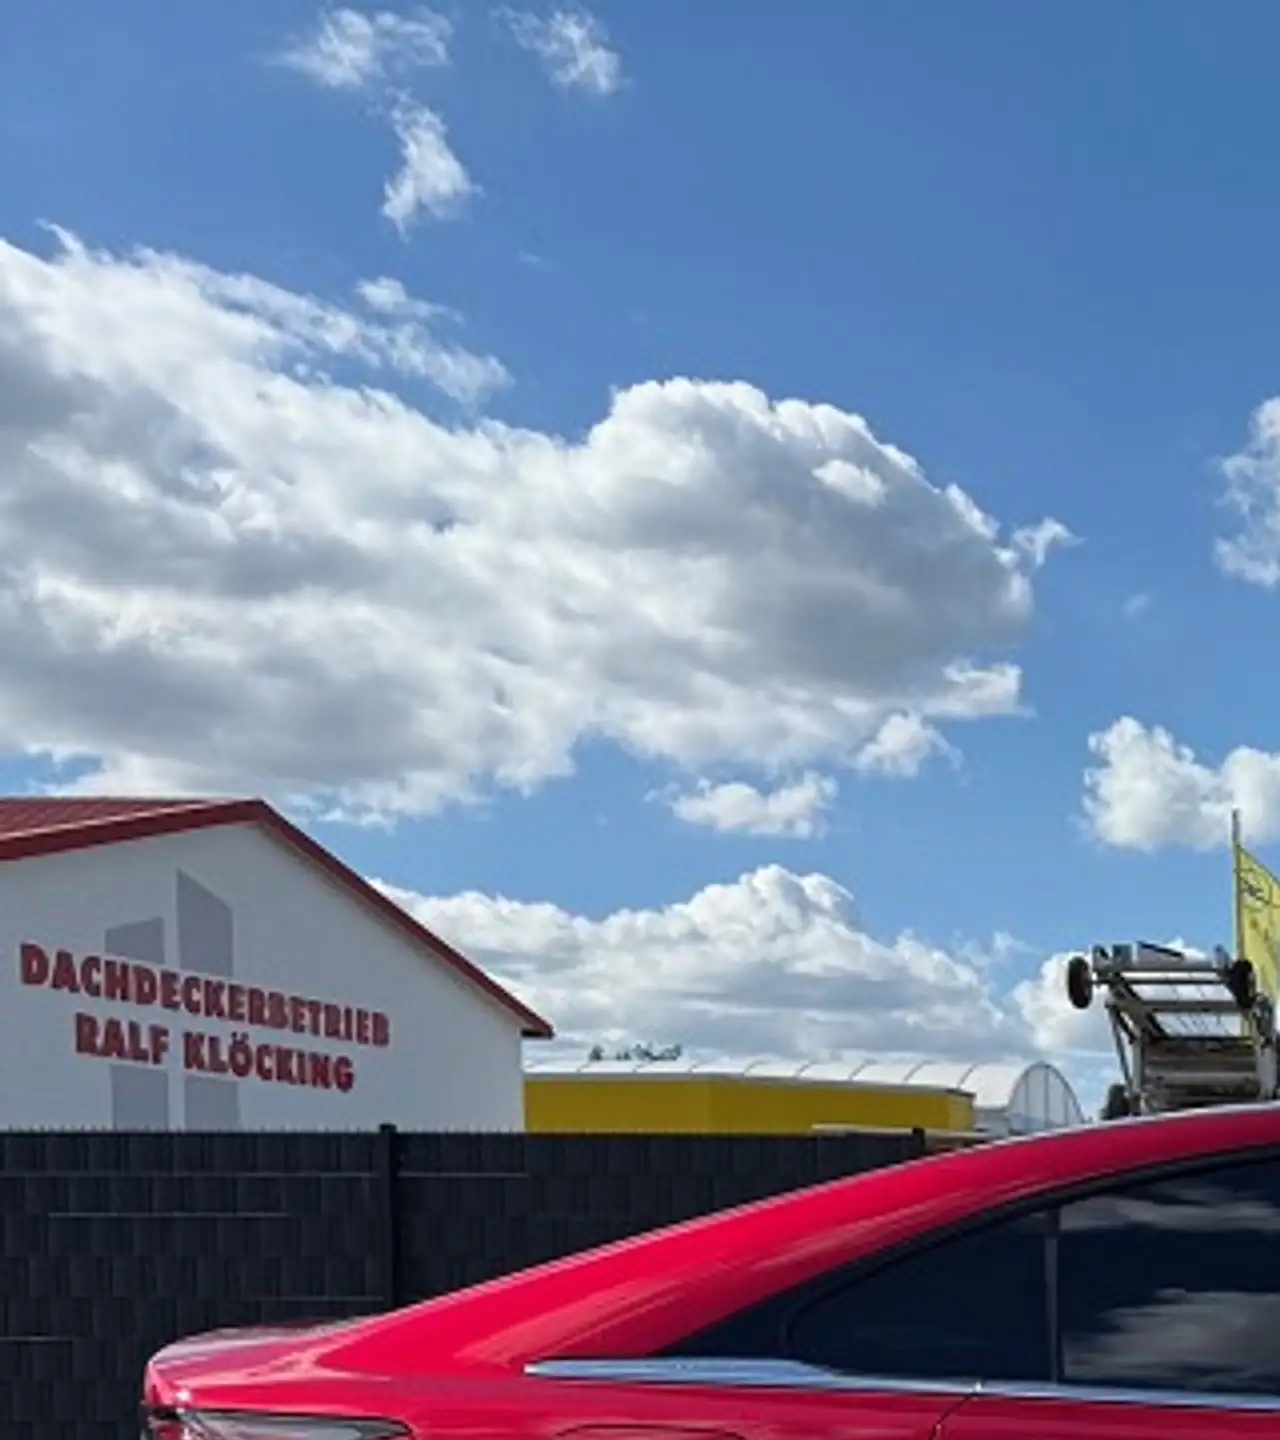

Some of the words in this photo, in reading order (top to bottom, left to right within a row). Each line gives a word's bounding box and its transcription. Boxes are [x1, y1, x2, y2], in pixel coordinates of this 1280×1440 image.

[19, 941, 391, 1048] DACHDECKERBETRIEB
[75, 1012, 170, 1065] RALF
[183, 1031, 355, 1092] KLÖCKING
